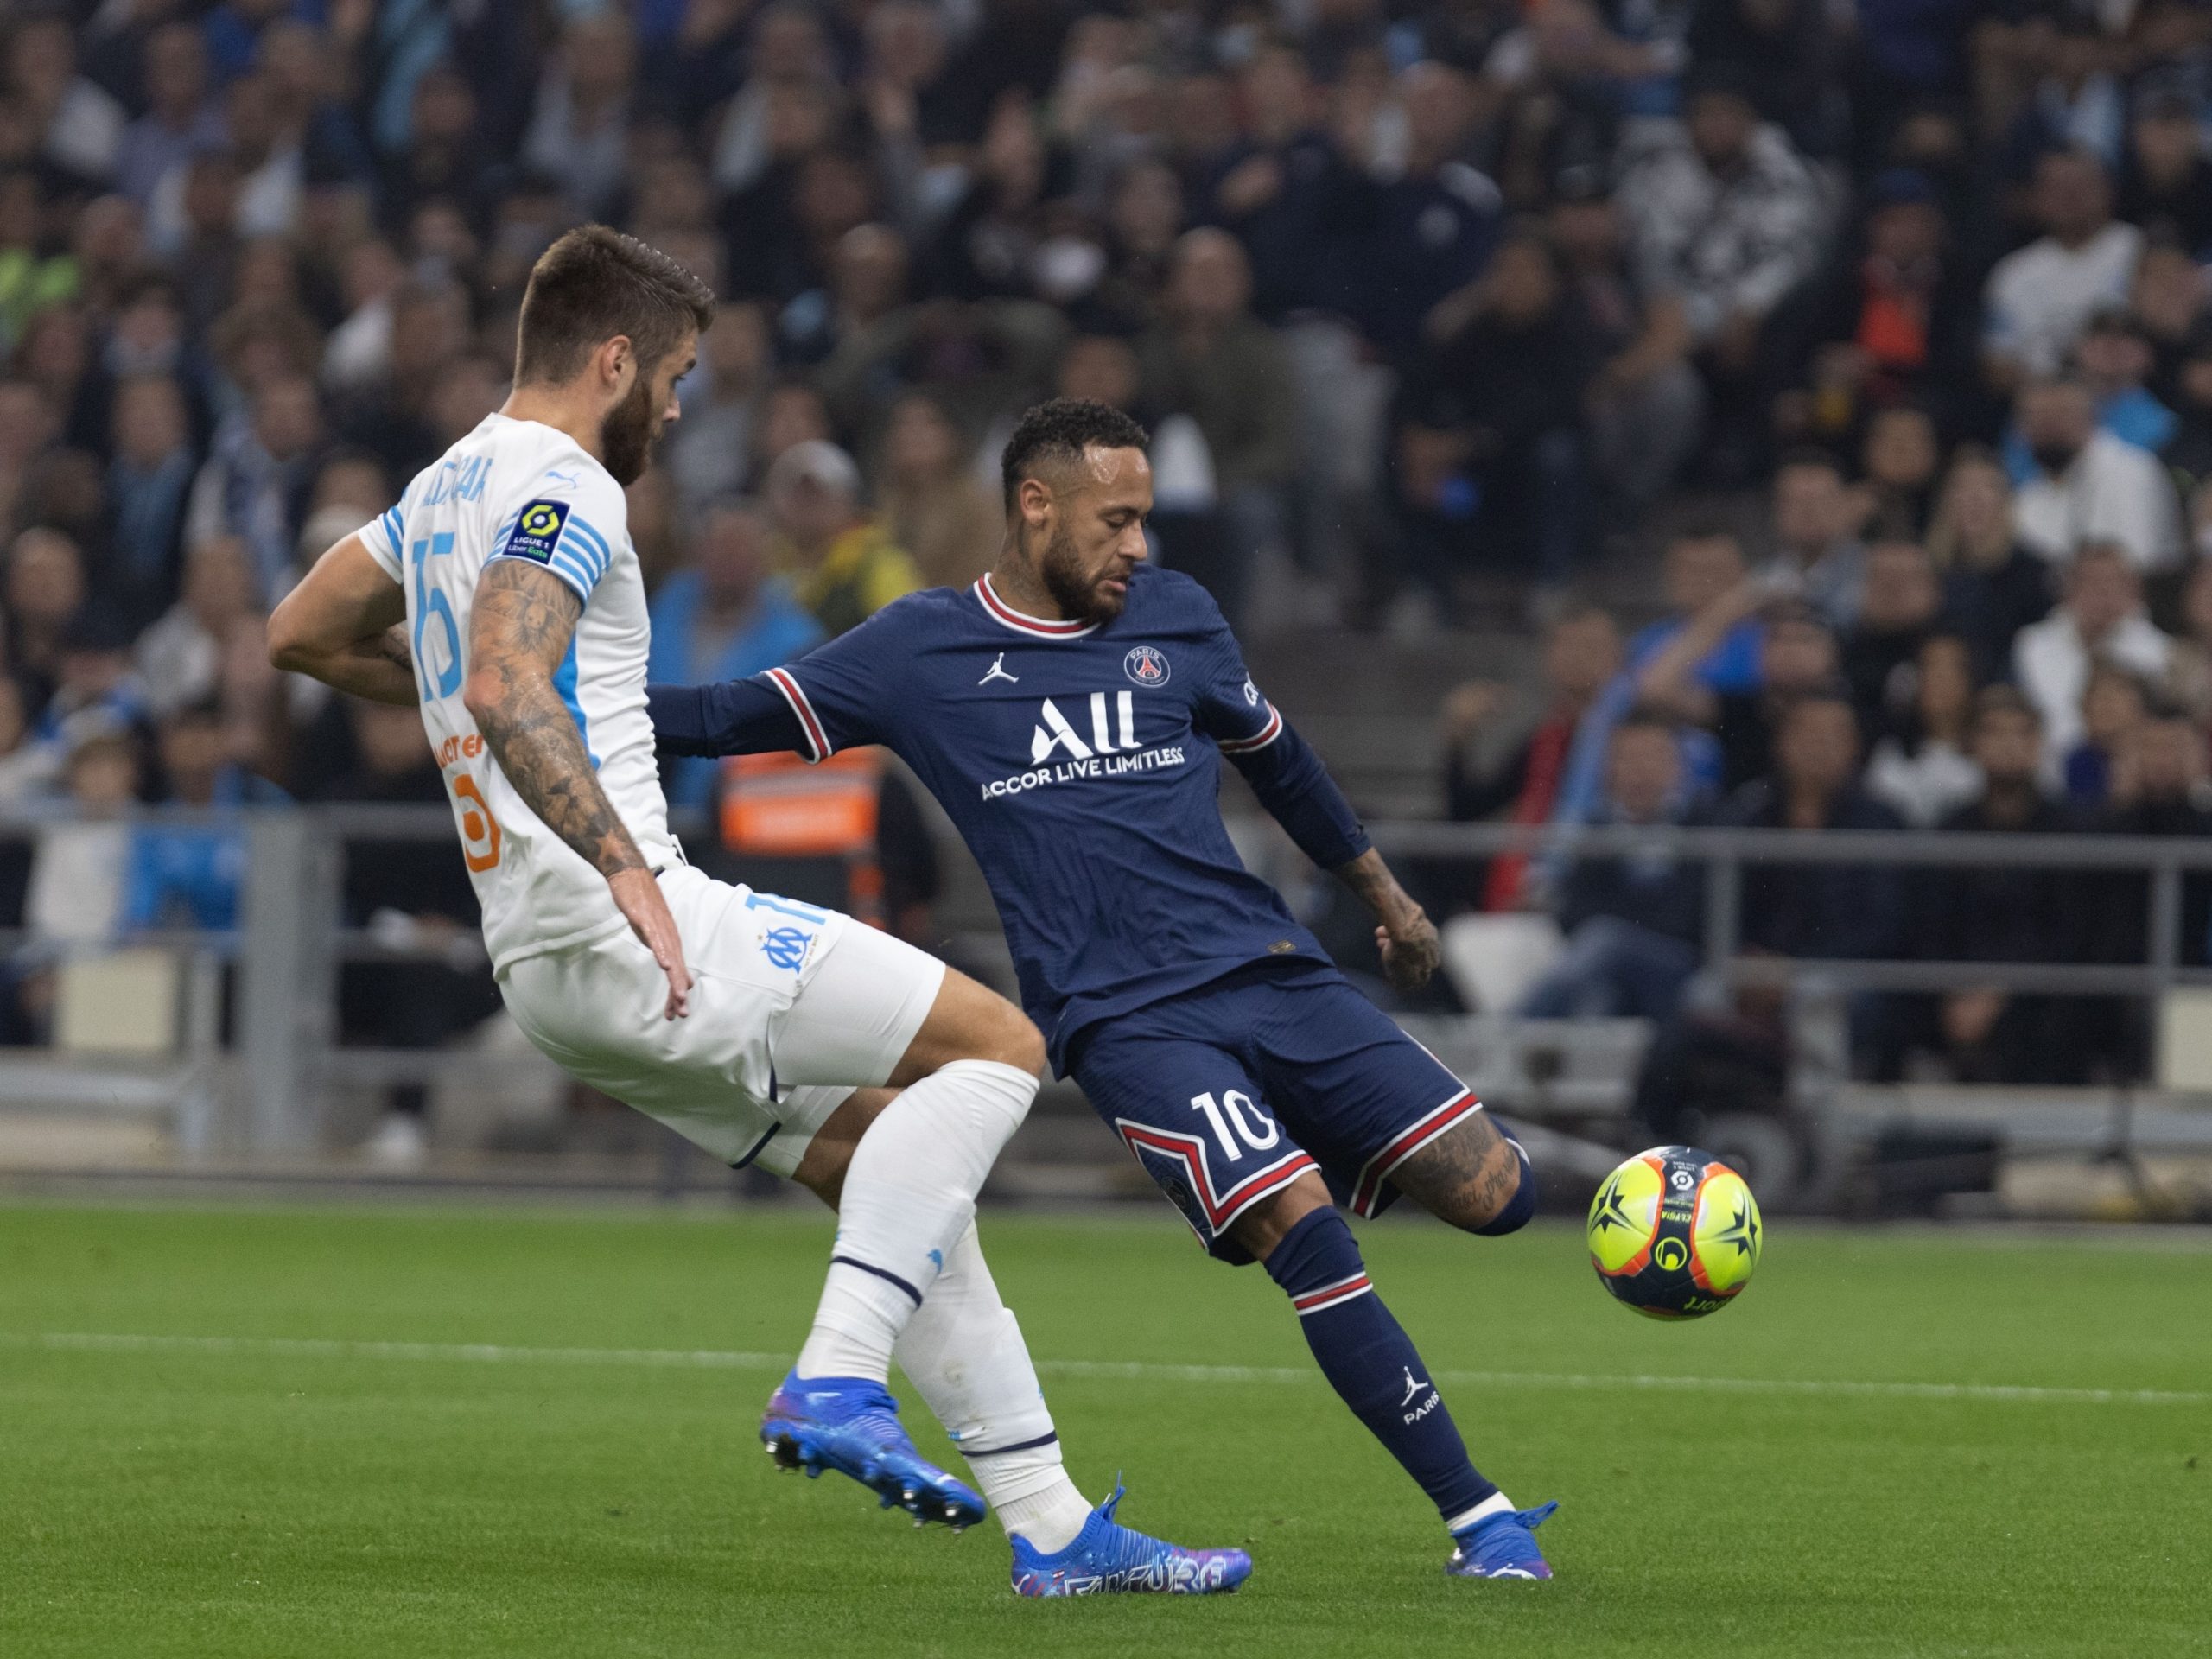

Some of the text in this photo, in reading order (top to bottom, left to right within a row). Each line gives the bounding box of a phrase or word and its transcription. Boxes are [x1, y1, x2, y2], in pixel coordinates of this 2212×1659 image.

[513, 537, 550, 550] LIGUE 1
[527, 545, 549, 558] Eats
[412, 531, 461, 702] 15
[1129, 648, 1160, 660] PARIS
[1030, 690, 1144, 766] ALL
[982, 747, 1185, 802] ACCOR LIVE LIMITLESS
[1190, 1089, 1280, 1162] 10
[1403, 1390, 1440, 1425] PARIS
